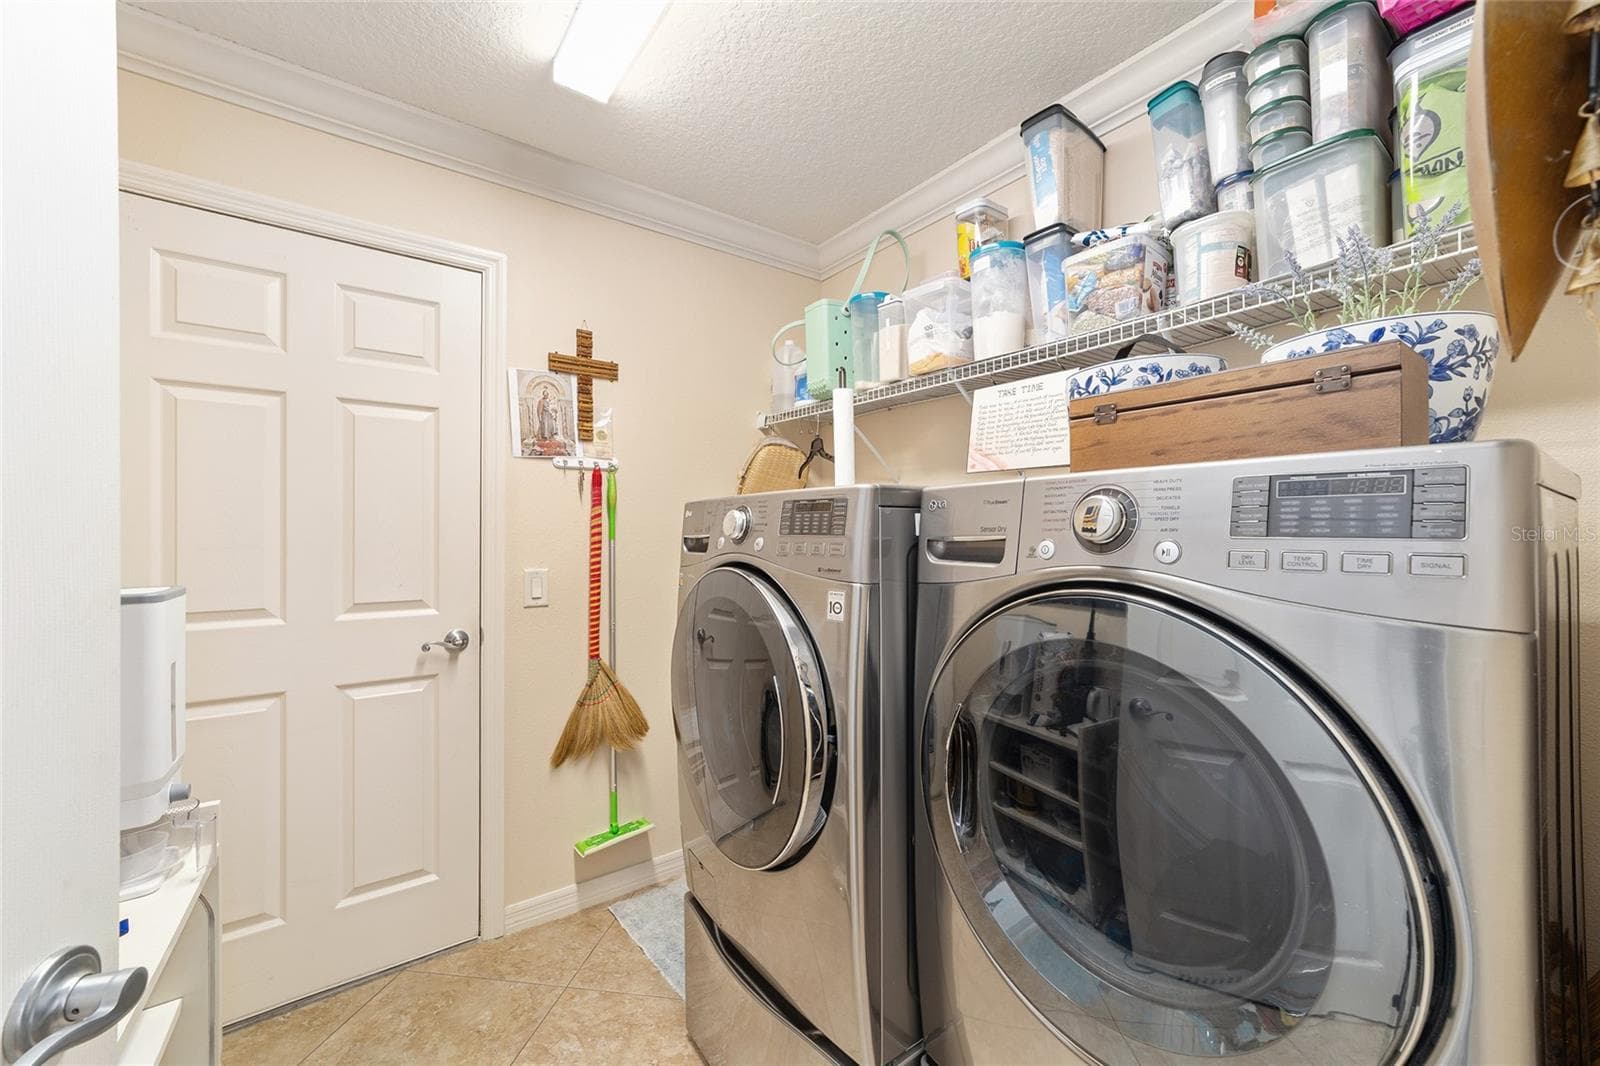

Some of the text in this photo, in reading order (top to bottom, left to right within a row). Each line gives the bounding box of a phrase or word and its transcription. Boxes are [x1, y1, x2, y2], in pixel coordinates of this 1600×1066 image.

[997, 382, 1044, 399] TAKE TIME
[998, 525, 1008, 535] Dry
